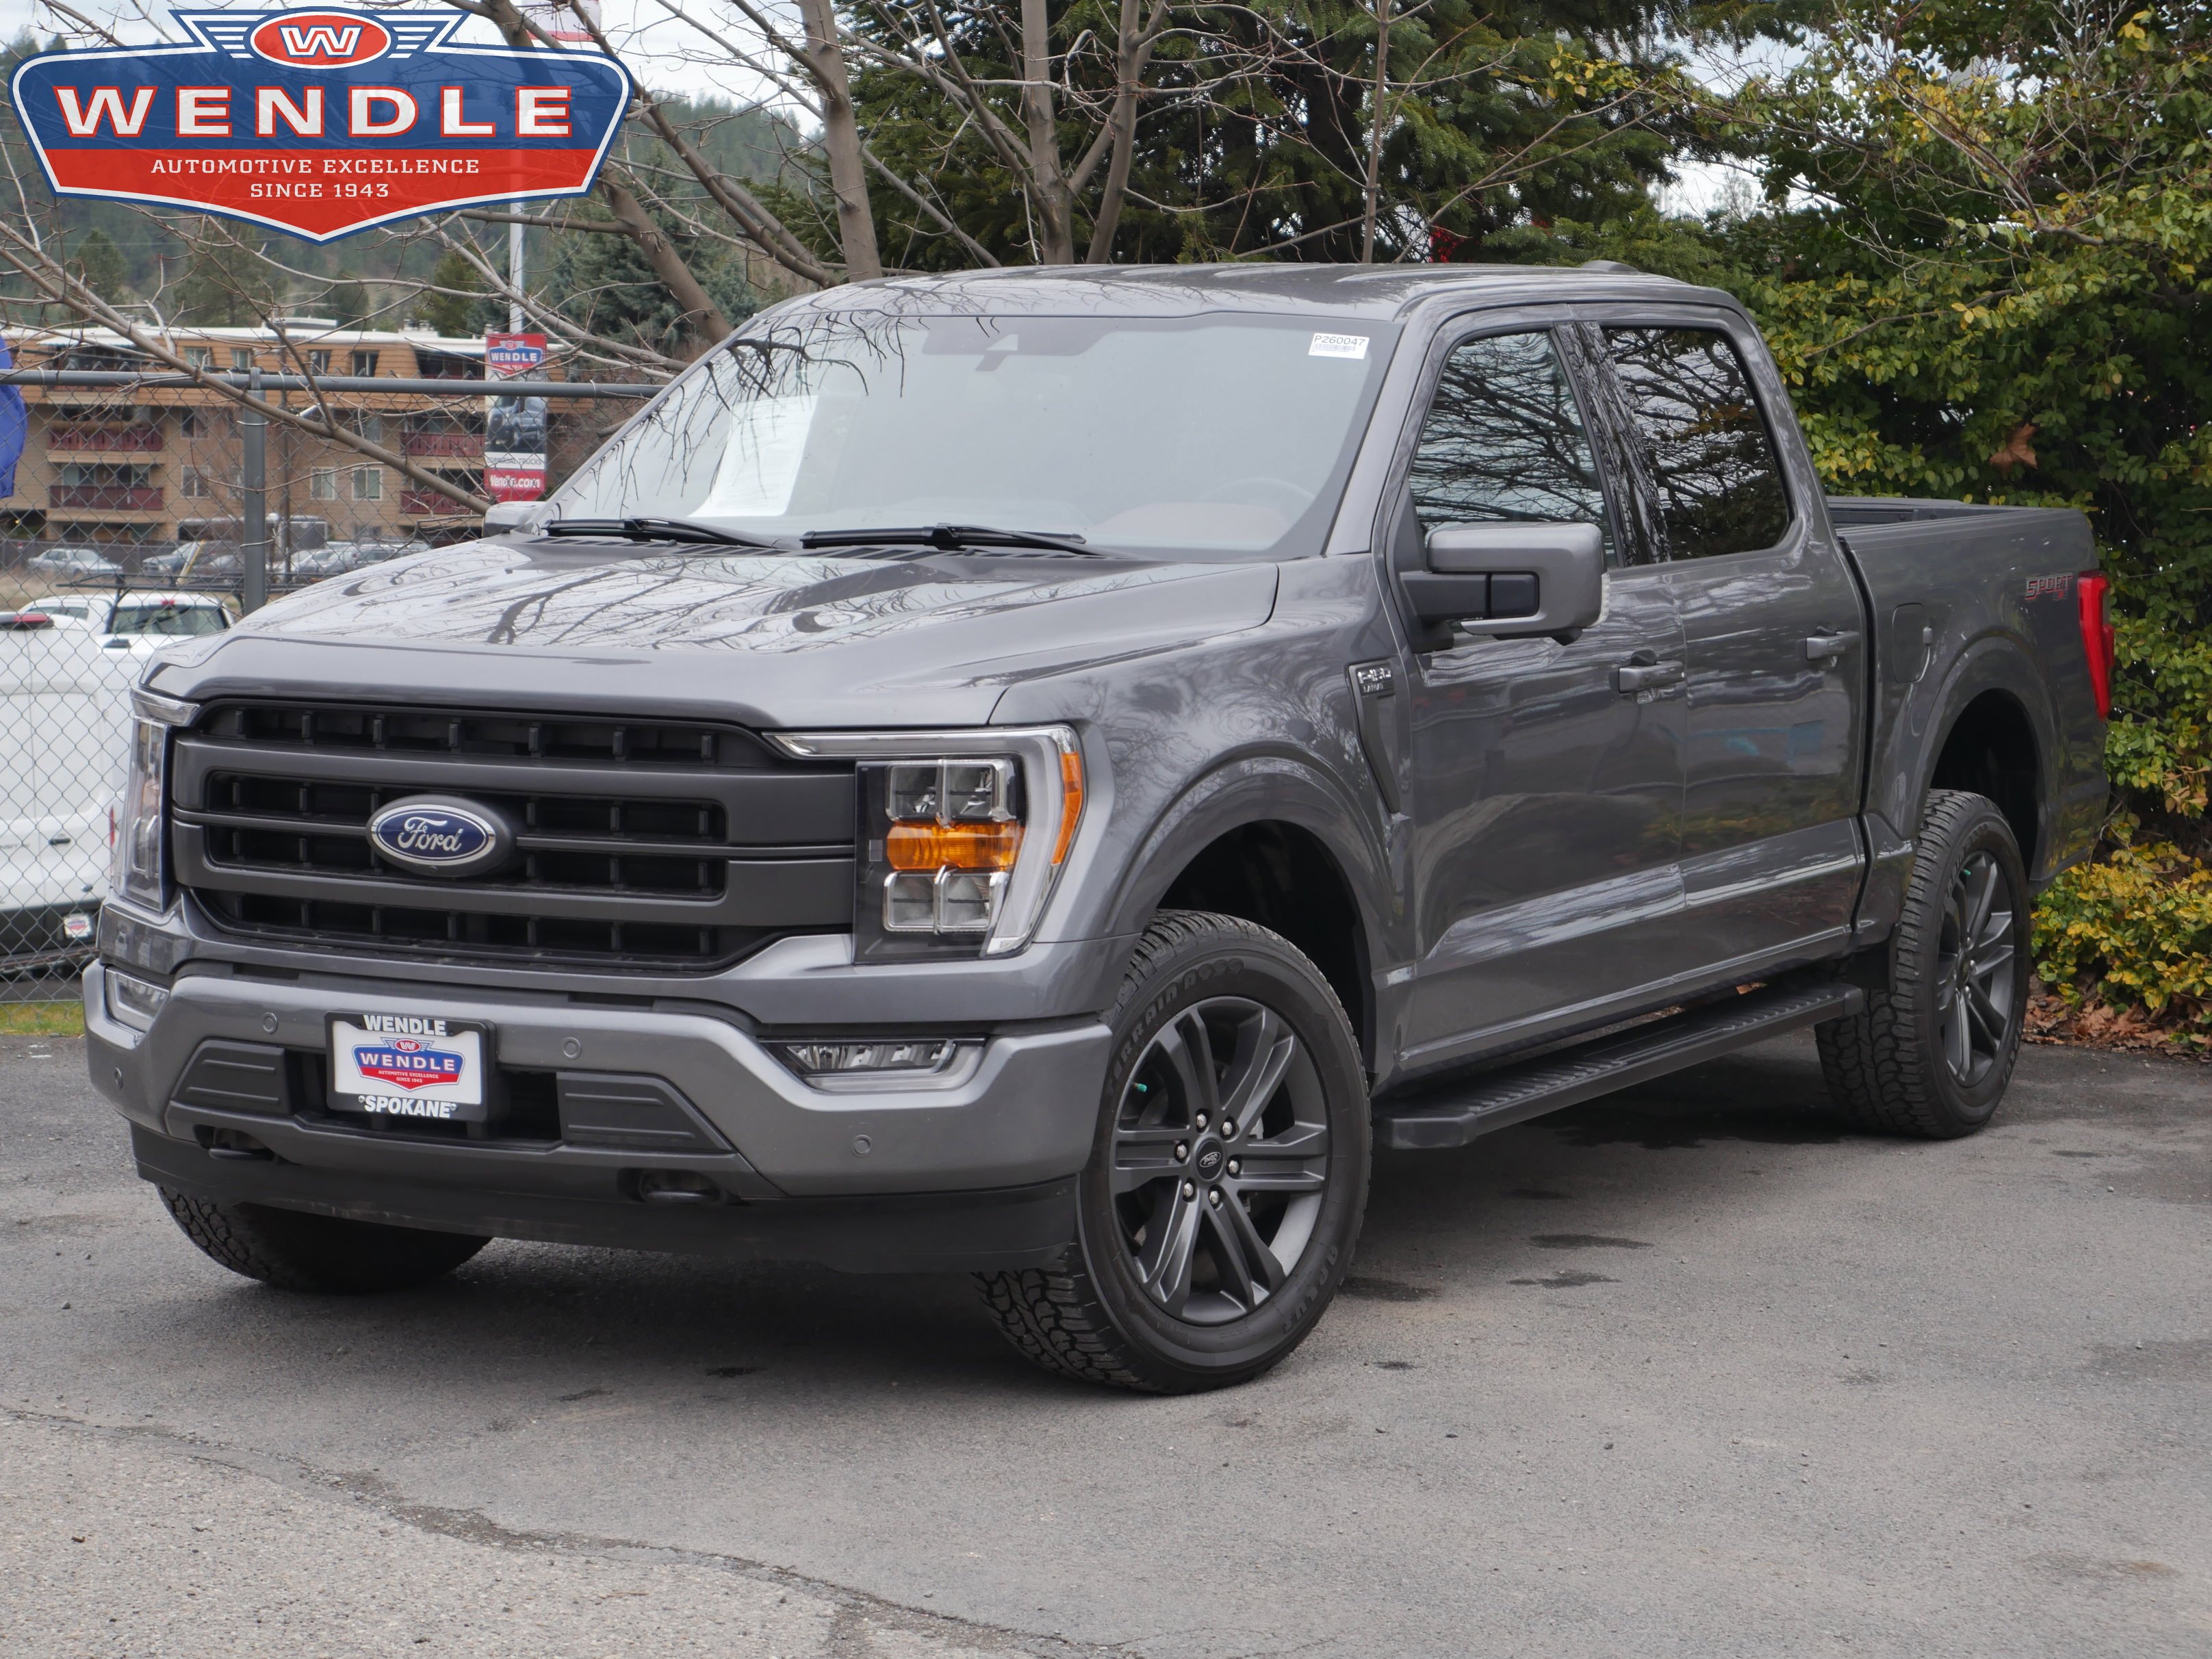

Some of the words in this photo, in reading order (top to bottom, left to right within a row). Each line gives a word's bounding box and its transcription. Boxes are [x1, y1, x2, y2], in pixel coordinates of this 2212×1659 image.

[1313, 335, 1365, 346] P260047
[491, 352, 537, 361] WENDLE
[519, 458, 541, 466] TRUCKS
[2025, 572, 2074, 600] SPORT
[398, 816, 463, 852] Ford
[363, 1014, 447, 1036] WENDLE
[359, 1052, 455, 1072] WENDLE
[363, 1094, 452, 1118] SPOKANE
